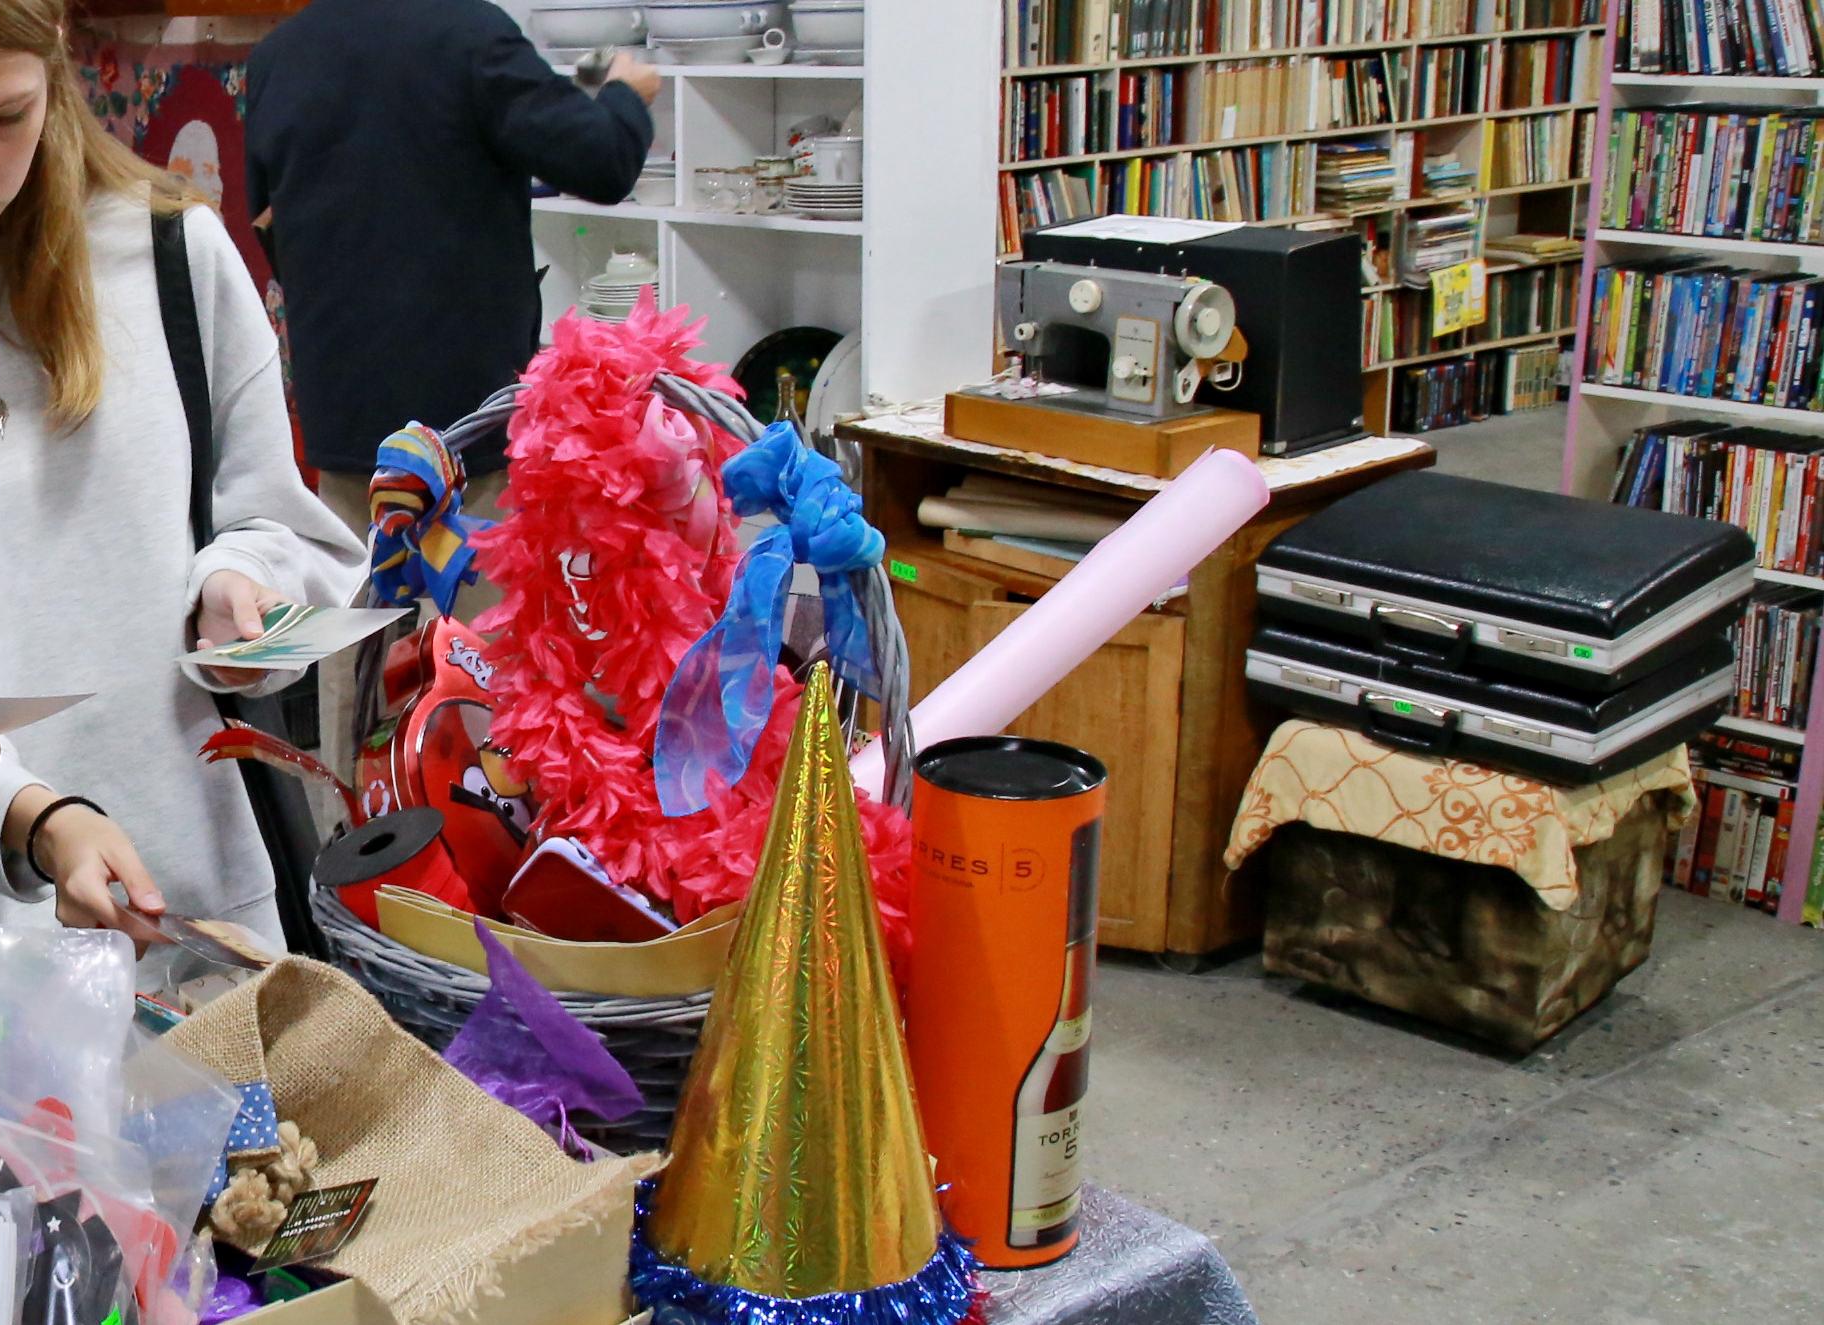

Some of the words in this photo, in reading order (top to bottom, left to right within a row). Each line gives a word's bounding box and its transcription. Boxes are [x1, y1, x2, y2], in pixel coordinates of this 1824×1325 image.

[1015, 860, 1033, 878] 5
[1038, 1120, 1080, 1147] TORR
[304, 1208, 351, 1225] многое
